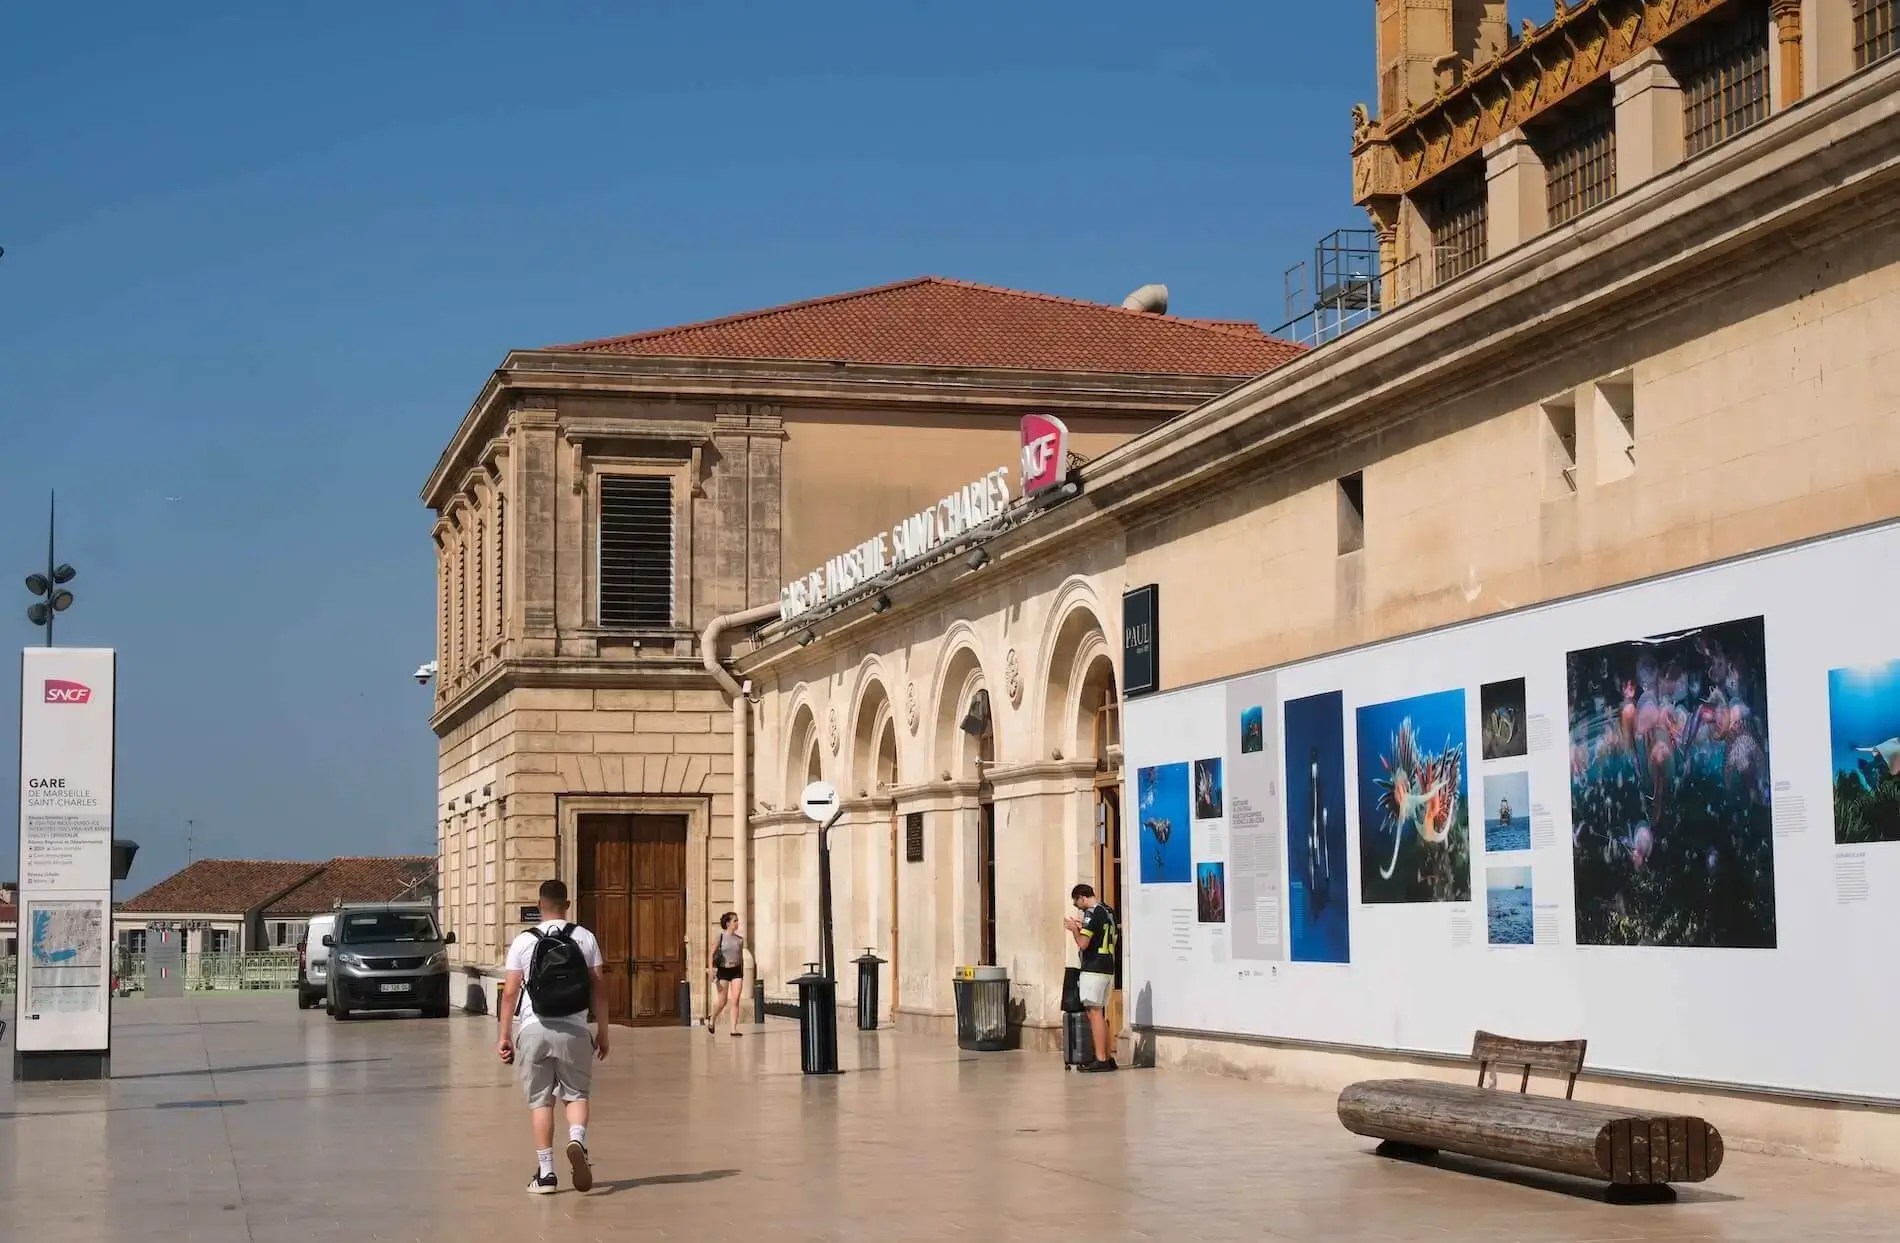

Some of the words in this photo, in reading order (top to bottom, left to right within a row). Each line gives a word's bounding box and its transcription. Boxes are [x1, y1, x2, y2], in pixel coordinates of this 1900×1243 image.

[1021, 432, 1056, 486] NCF
[780, 577, 811, 621] GARE
[809, 567, 826, 609] DE
[892, 505, 937, 568] SAINT
[937, 466, 1010, 545] CHARLES
[1125, 623, 1149, 649] PAUL
[46, 688, 89, 701] SNCF
[29, 778, 66, 788] GARE
[28, 789, 41, 798] DE
[43, 789, 91, 798] MARSEILLE
